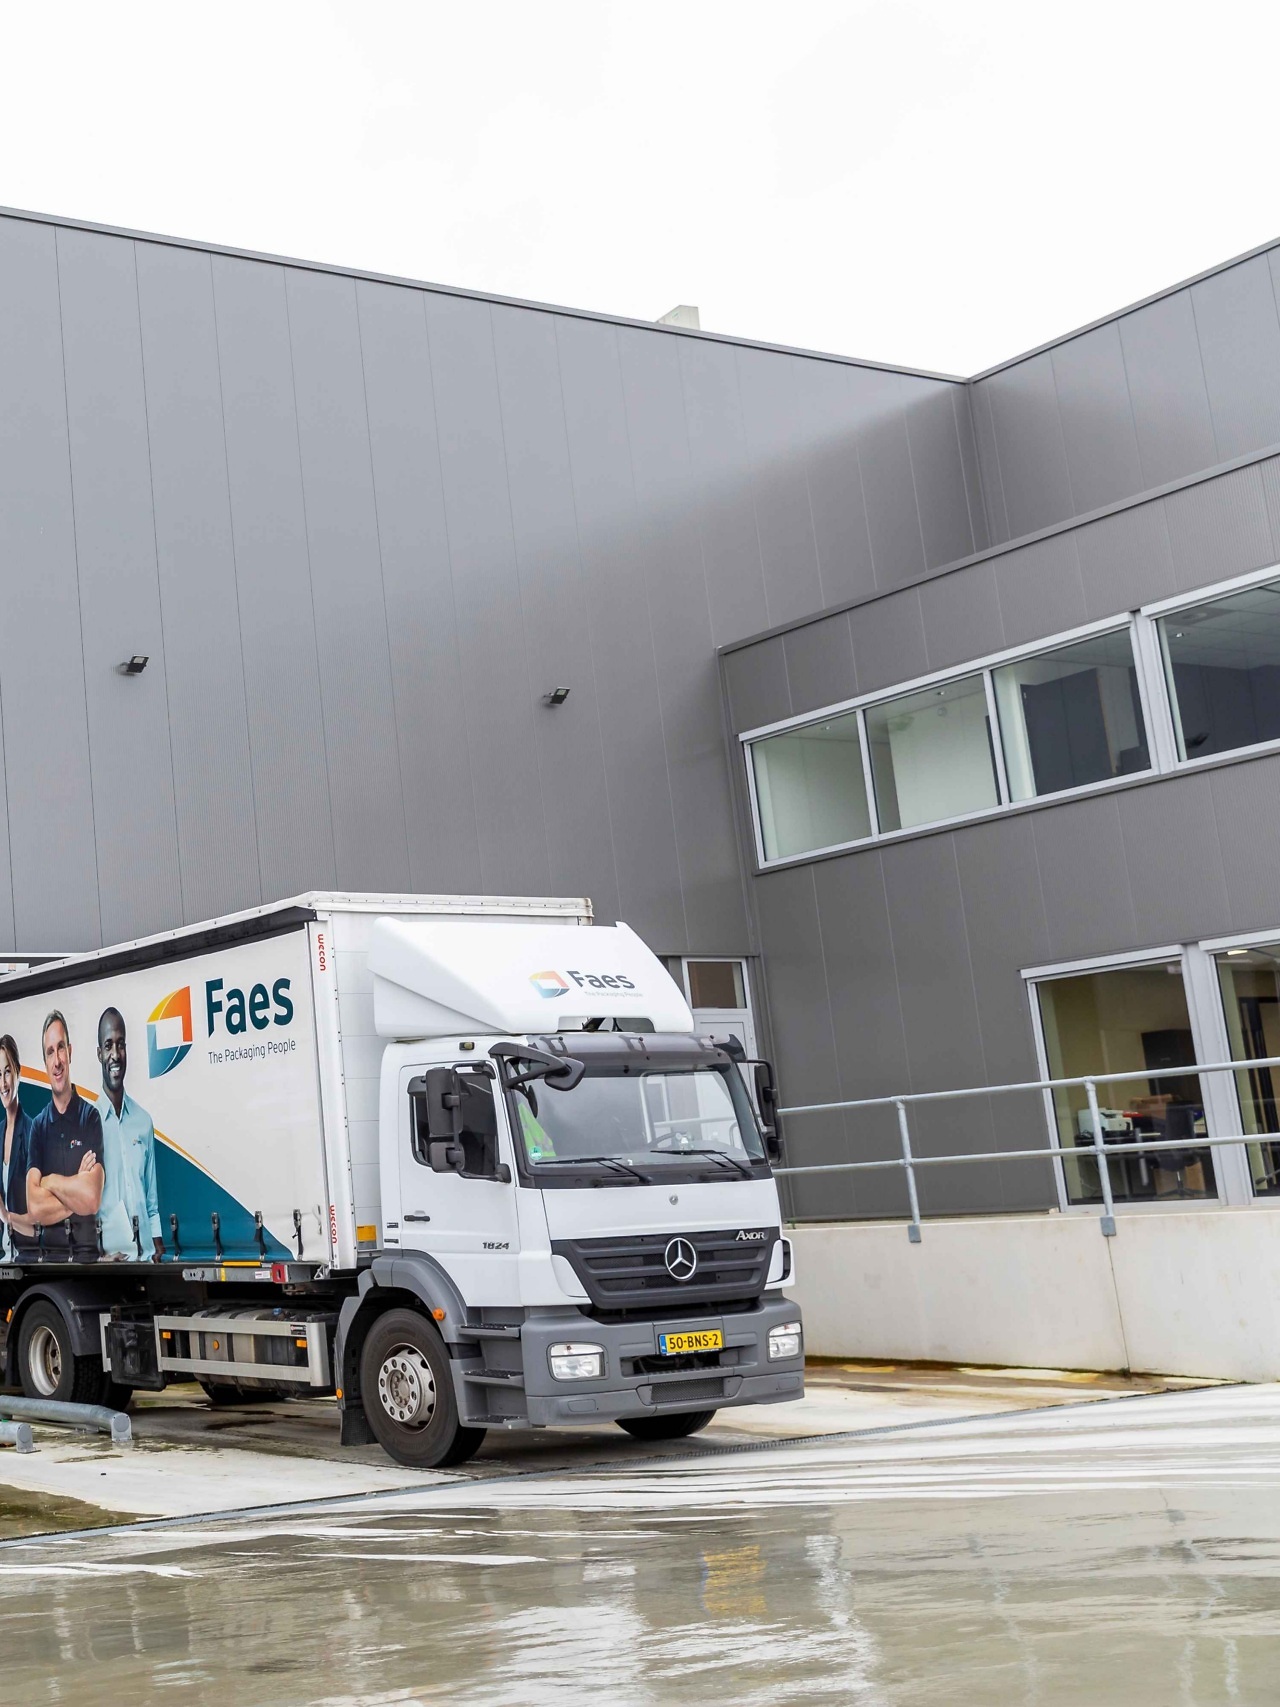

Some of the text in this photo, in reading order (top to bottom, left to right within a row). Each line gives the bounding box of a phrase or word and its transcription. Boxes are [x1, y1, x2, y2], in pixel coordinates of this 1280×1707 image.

[317, 934, 326, 971] wecon
[566, 970, 635, 989] Faes
[205, 978, 294, 1038] Faes
[208, 1038, 296, 1064] The Packaging People
[330, 1205, 338, 1244] wecon
[482, 1242, 509, 1250] 1824
[669, 1332, 719, 1350] 50-BNS-2
